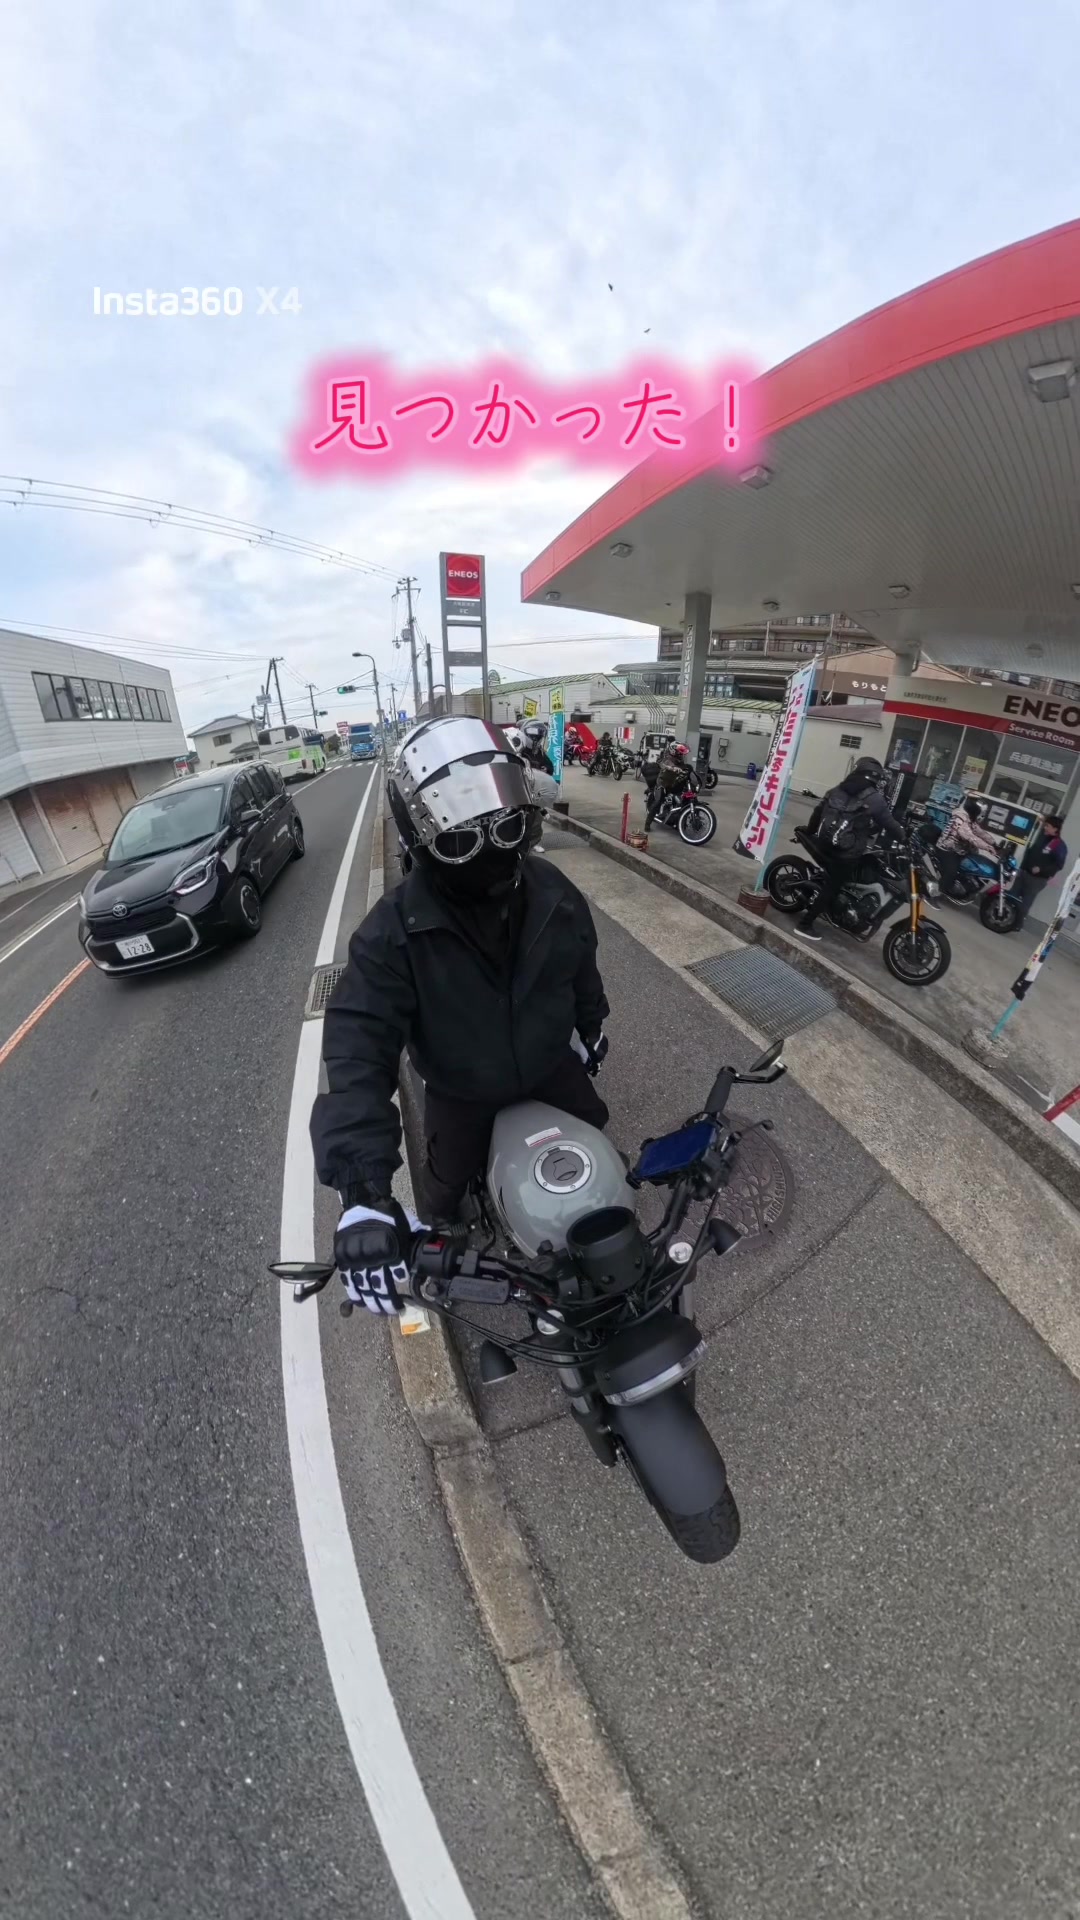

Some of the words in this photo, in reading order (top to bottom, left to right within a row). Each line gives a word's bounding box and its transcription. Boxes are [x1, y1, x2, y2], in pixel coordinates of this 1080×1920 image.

[447, 569, 479, 579] ENEOS
[1008, 722, 1045, 739] Service
[1045, 731, 1075, 747] Room
